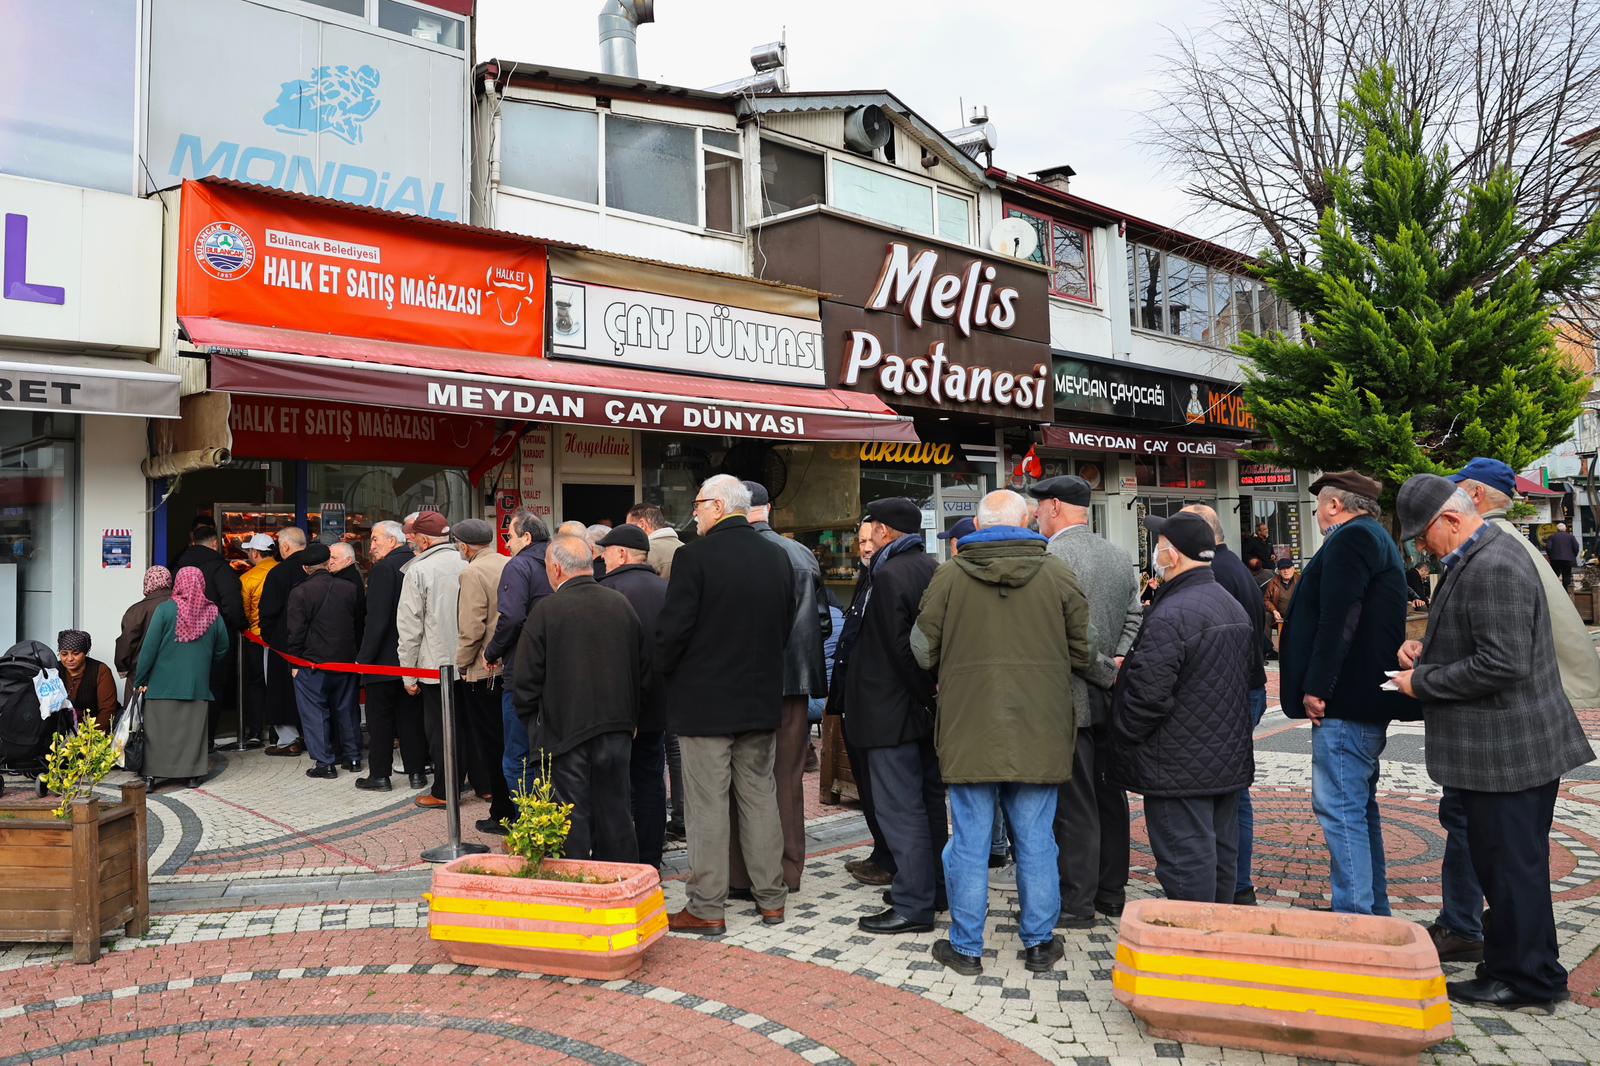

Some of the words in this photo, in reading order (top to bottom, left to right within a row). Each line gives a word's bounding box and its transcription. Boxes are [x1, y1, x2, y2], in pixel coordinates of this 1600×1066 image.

[4, 213, 65, 306] L
[196, 223, 223, 260] BULANCAK
[206, 247, 244, 257] BULANCAK
[269, 233, 320, 251] Bulancak
[323, 242, 377, 260] Belediyesi
[263, 255, 314, 292] HALK
[319, 264, 341, 295] ET
[346, 268, 395, 310] SATIŞ
[400, 274, 482, 316] MAĞAZASI
[495, 267, 515, 281] HALK
[515, 271, 525, 283] ET
[867, 242, 1020, 337] Melis
[604, 301, 675, 357] ÇAY
[686, 305, 824, 371] DÜNYASI
[840, 329, 1048, 410] Pastanesi
[1054, 373, 1107, 399] MEYDAN
[231, 403, 276, 434] HALK
[280, 406, 300, 434] ET
[304, 407, 352, 443] SATIŞ
[358, 407, 436, 442] MAĞAZASI
[428, 383, 585, 418] MEYDAN
[604, 400, 668, 424] ÇAY
[683, 406, 805, 435] DÜNYASI
[1208, 389, 1258, 432] MEYDA
[564, 432, 630, 459] Hoşgeldiniz
[1068, 431, 1136, 450] MEYDAN
[1143, 439, 1169, 454] ÇAY
[1177, 440, 1216, 455] OCAĞI
